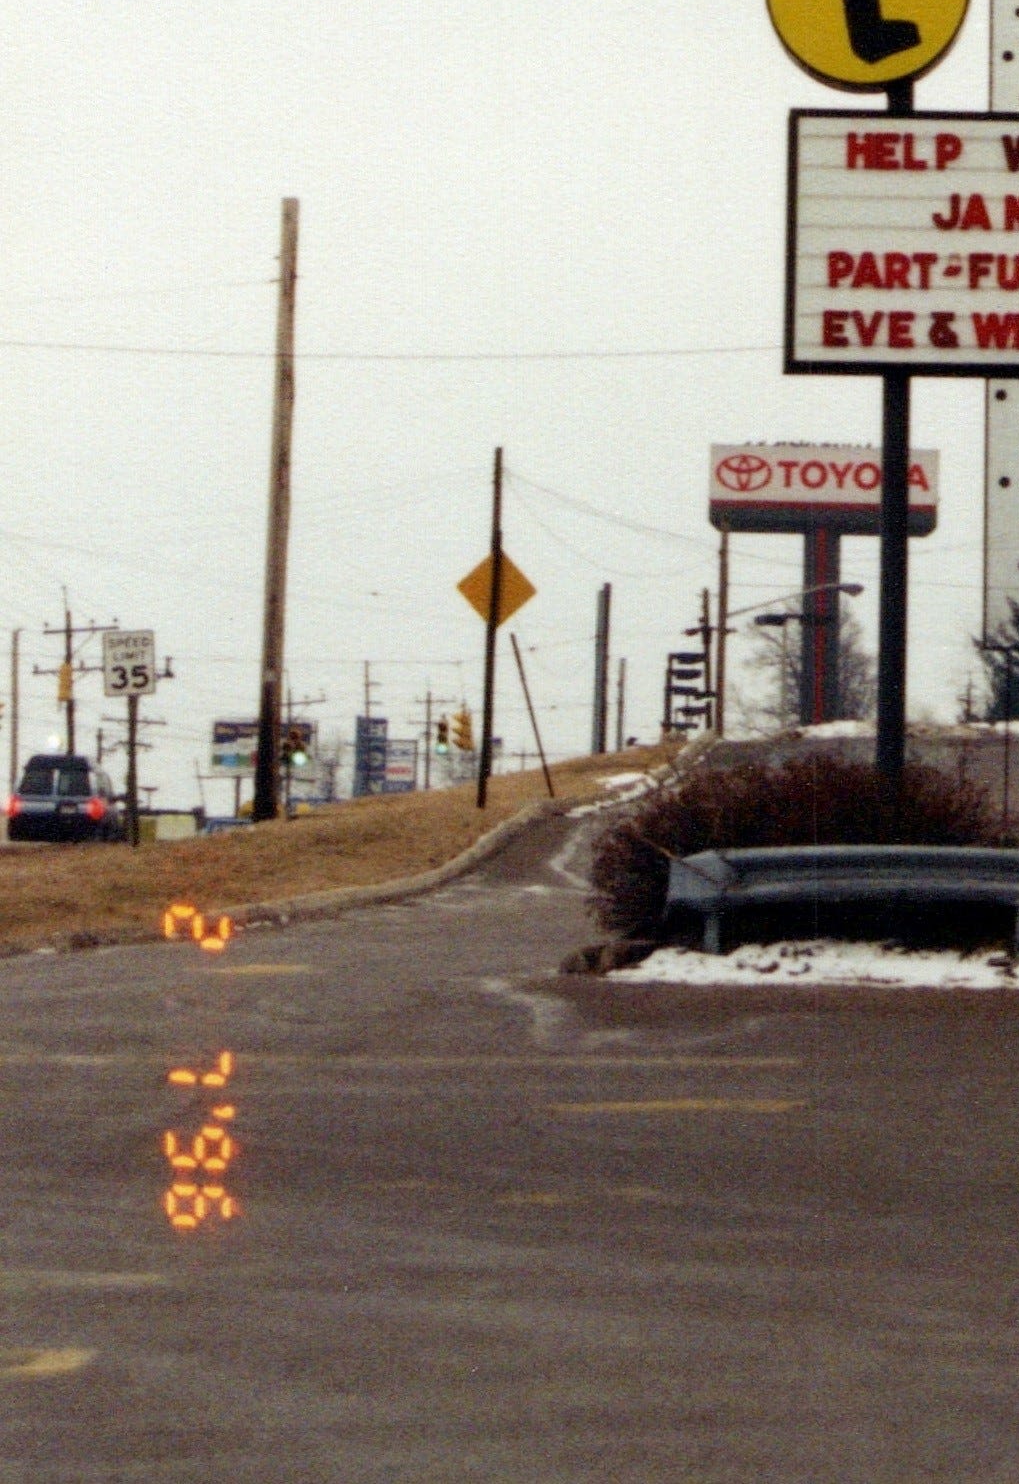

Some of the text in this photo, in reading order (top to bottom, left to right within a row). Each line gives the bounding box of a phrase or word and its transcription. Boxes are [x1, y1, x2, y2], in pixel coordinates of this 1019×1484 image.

[845, 132, 963, 171] HELP
[822, 310, 916, 349] EVE
[928, 312, 960, 349] &
[777, 459, 930, 492] TOYOA
[108, 636, 150, 648] SPEED
[111, 665, 150, 690] 35
